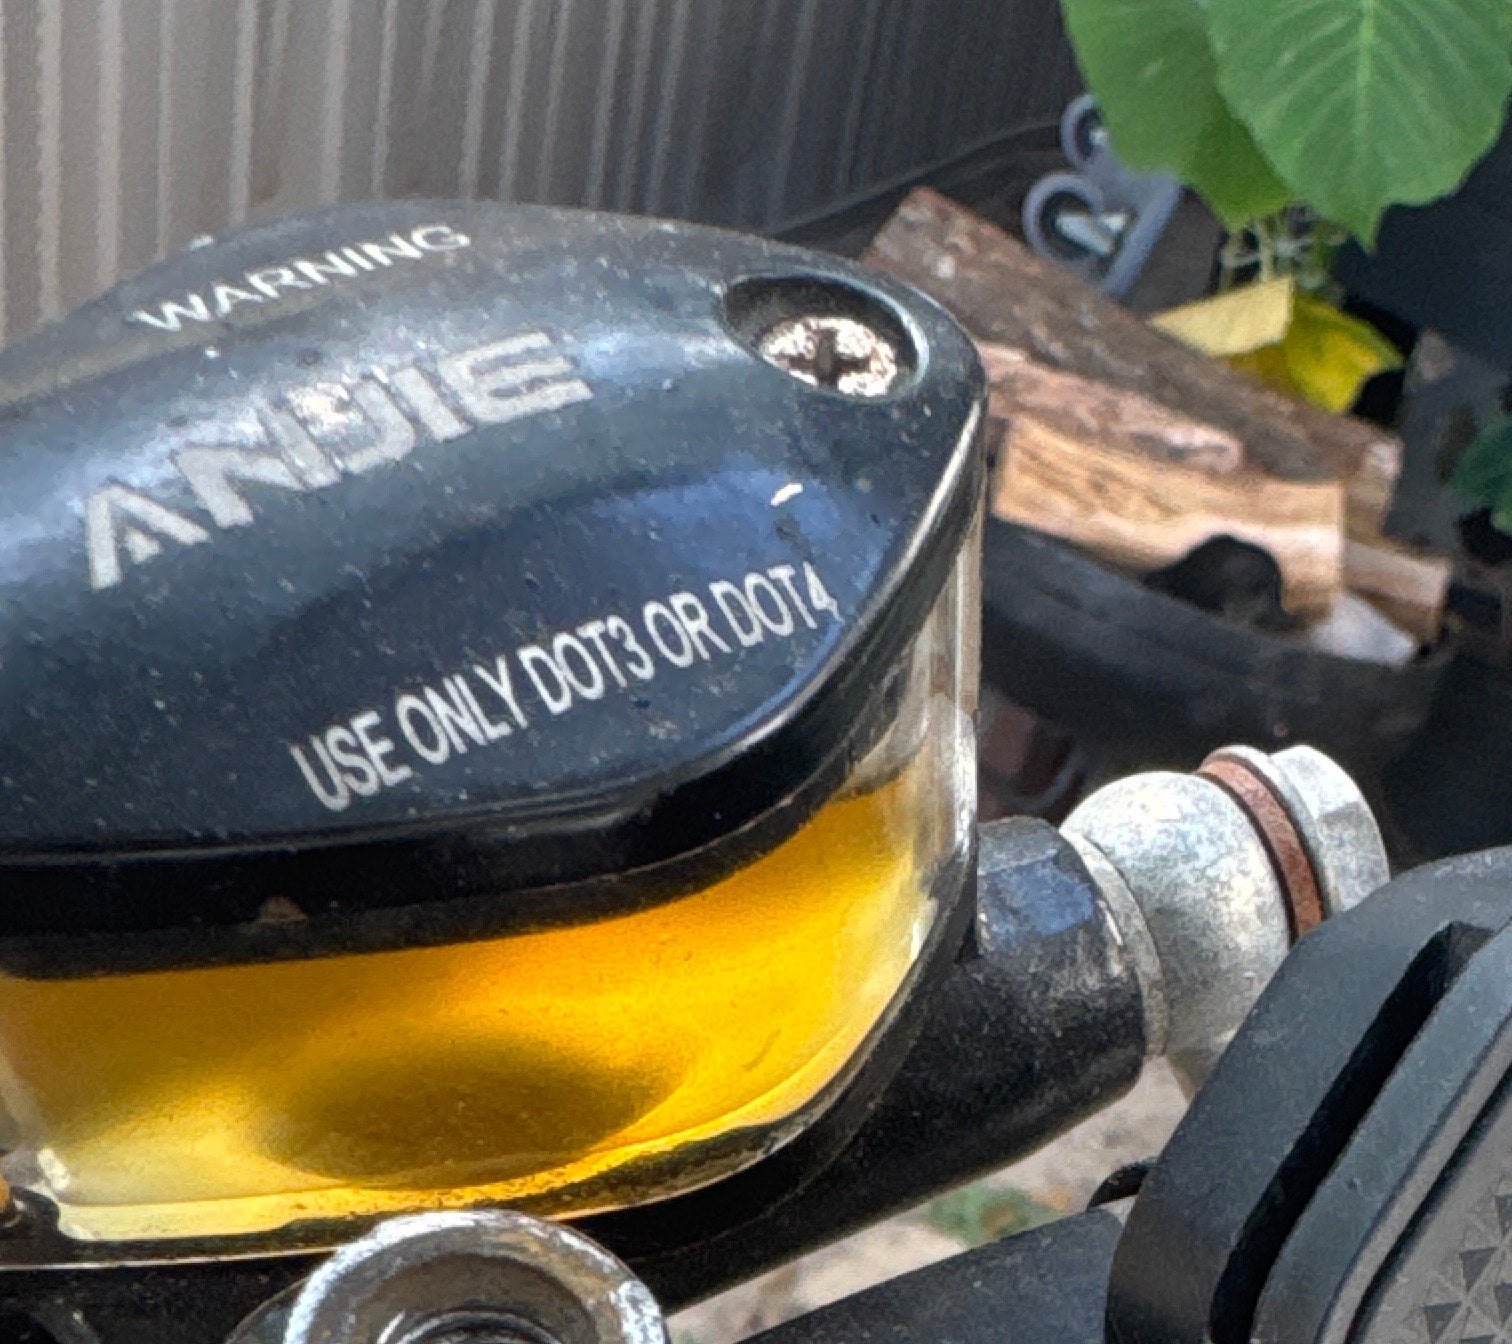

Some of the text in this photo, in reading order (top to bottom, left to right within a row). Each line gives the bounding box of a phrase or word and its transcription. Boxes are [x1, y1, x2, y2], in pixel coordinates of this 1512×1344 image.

[131, 224, 471, 332] WARNING
[289, 560, 845, 812] USE ONLY DOT3 OR DOT4
